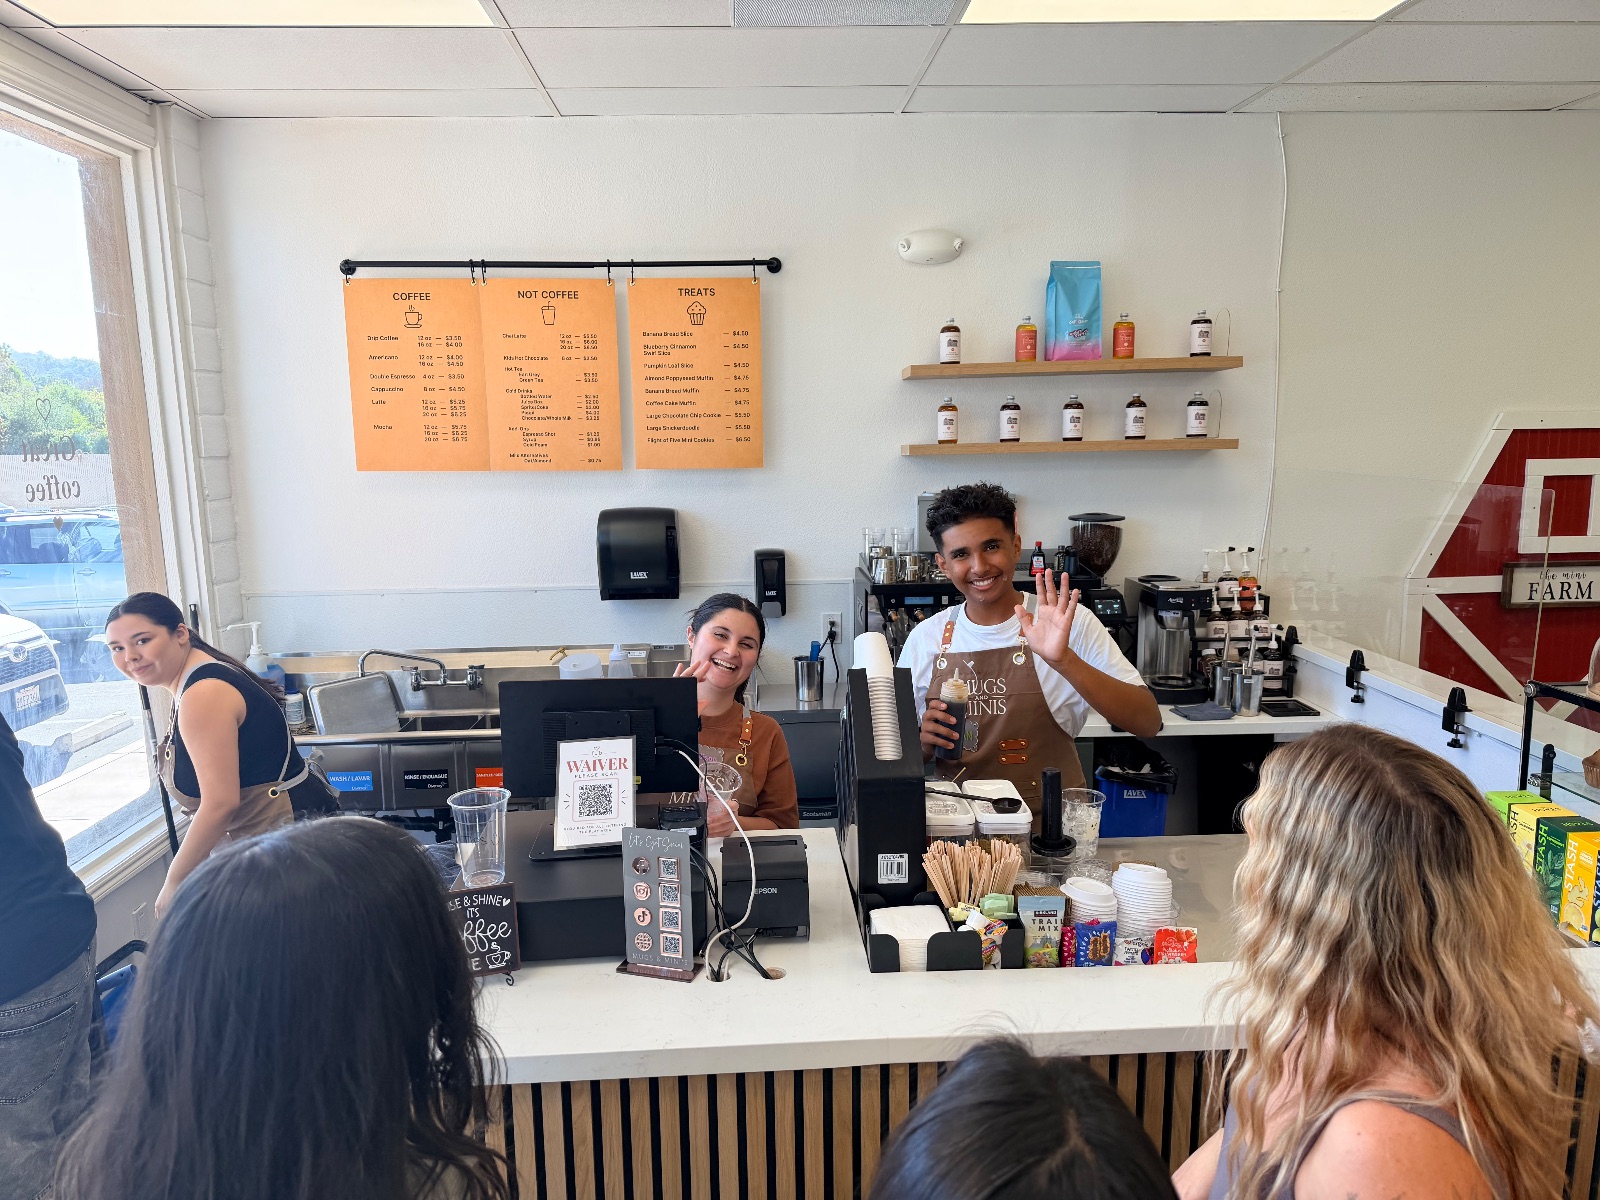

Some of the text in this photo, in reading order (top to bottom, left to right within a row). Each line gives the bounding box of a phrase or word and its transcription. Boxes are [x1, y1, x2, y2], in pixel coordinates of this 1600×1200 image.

[392, 292, 431, 301] COFFEE
[517, 290, 579, 299] NOT COFFEE
[678, 287, 716, 297] TREATS
[630, 571, 649, 580] LAVEX
[1539, 568, 1587, 580] the mini
[1527, 580, 1594, 601] FARM
[566, 757, 629, 774] WAIVER
[1123, 789, 1147, 799] LAVEX
[802, 810, 832, 818] Scotsman
[1510, 810, 1519, 843] ASH
[1535, 823, 1548, 875] STASH
[1564, 839, 1578, 892] STASH
[463, 895, 471, 907] &
[472, 894, 503, 907] SHINE
[463, 918, 512, 954] ffee
[632, 952, 654, 962] MUGS
